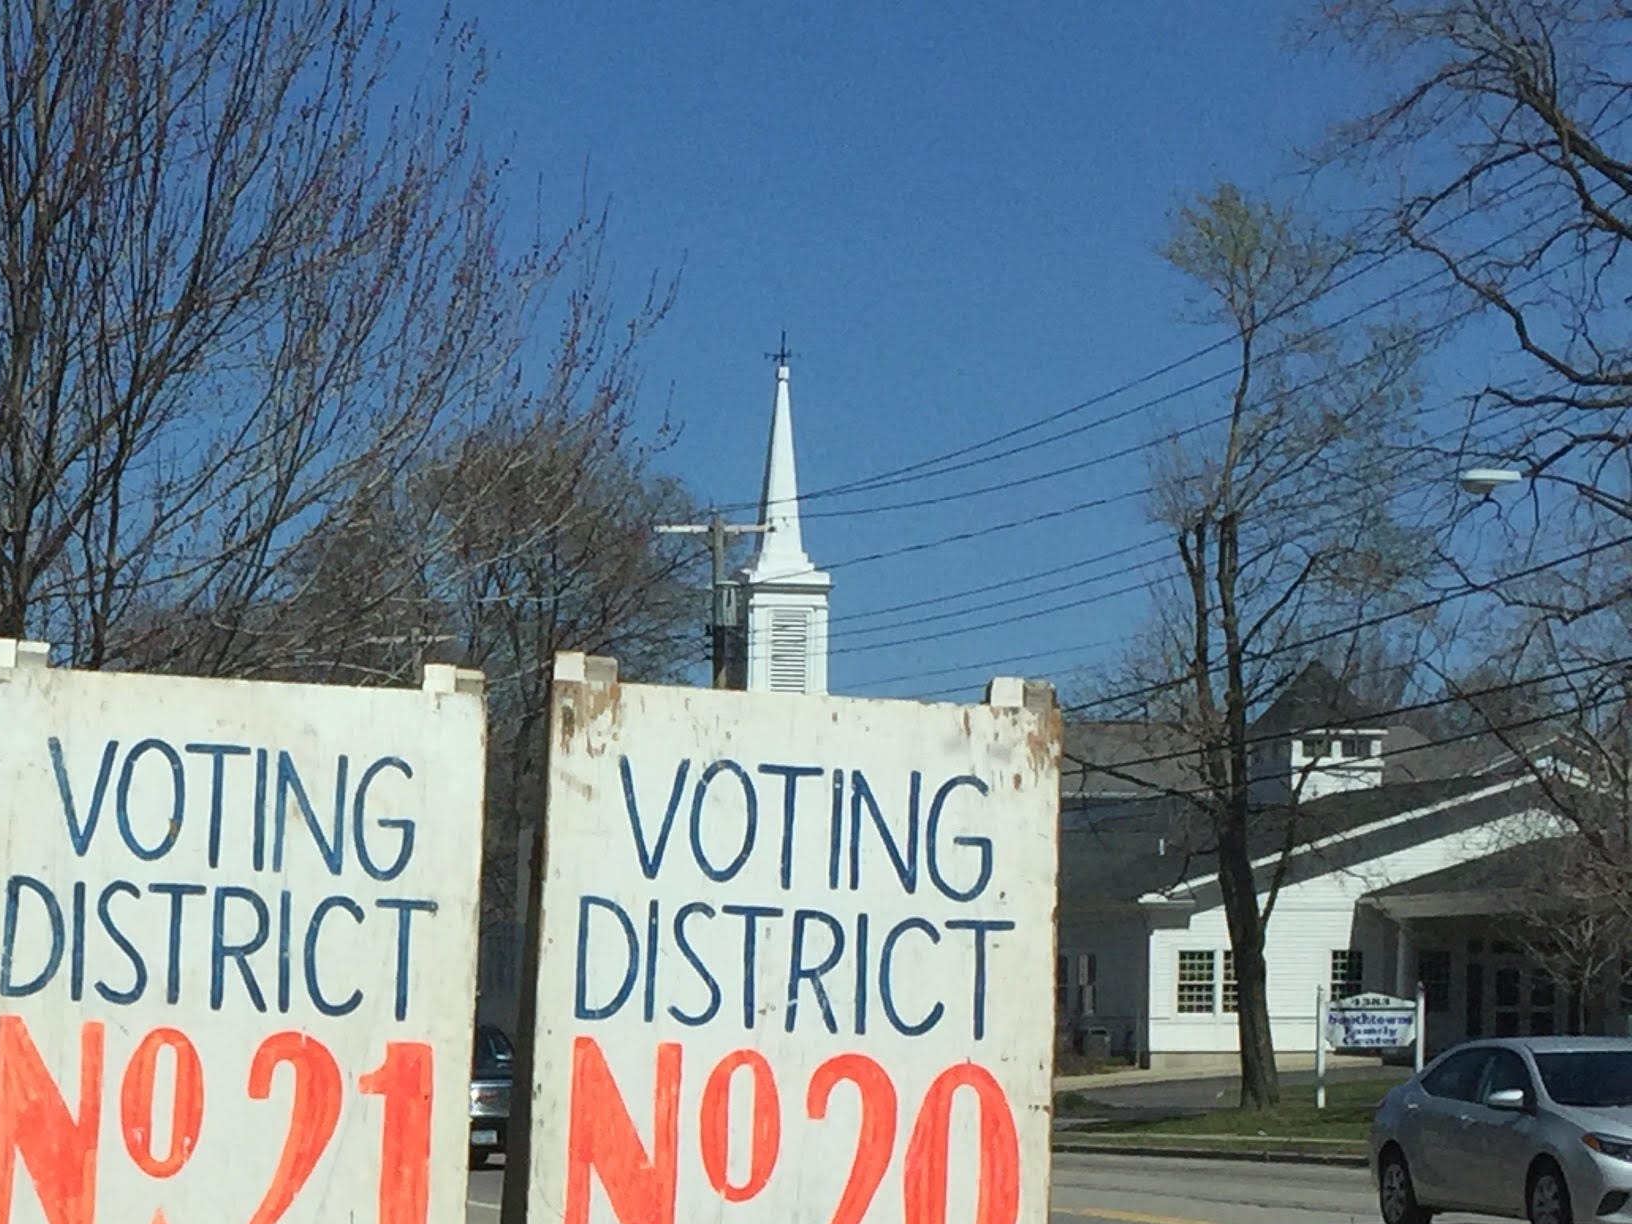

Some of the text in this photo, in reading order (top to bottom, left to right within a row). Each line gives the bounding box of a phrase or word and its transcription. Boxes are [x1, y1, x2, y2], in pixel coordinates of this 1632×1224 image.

[49, 736, 416, 883] VOTING
[621, 756, 995, 901] VOTING
[0, 875, 435, 1019] DISTRICT
[575, 896, 1014, 1040] DISTRICT
